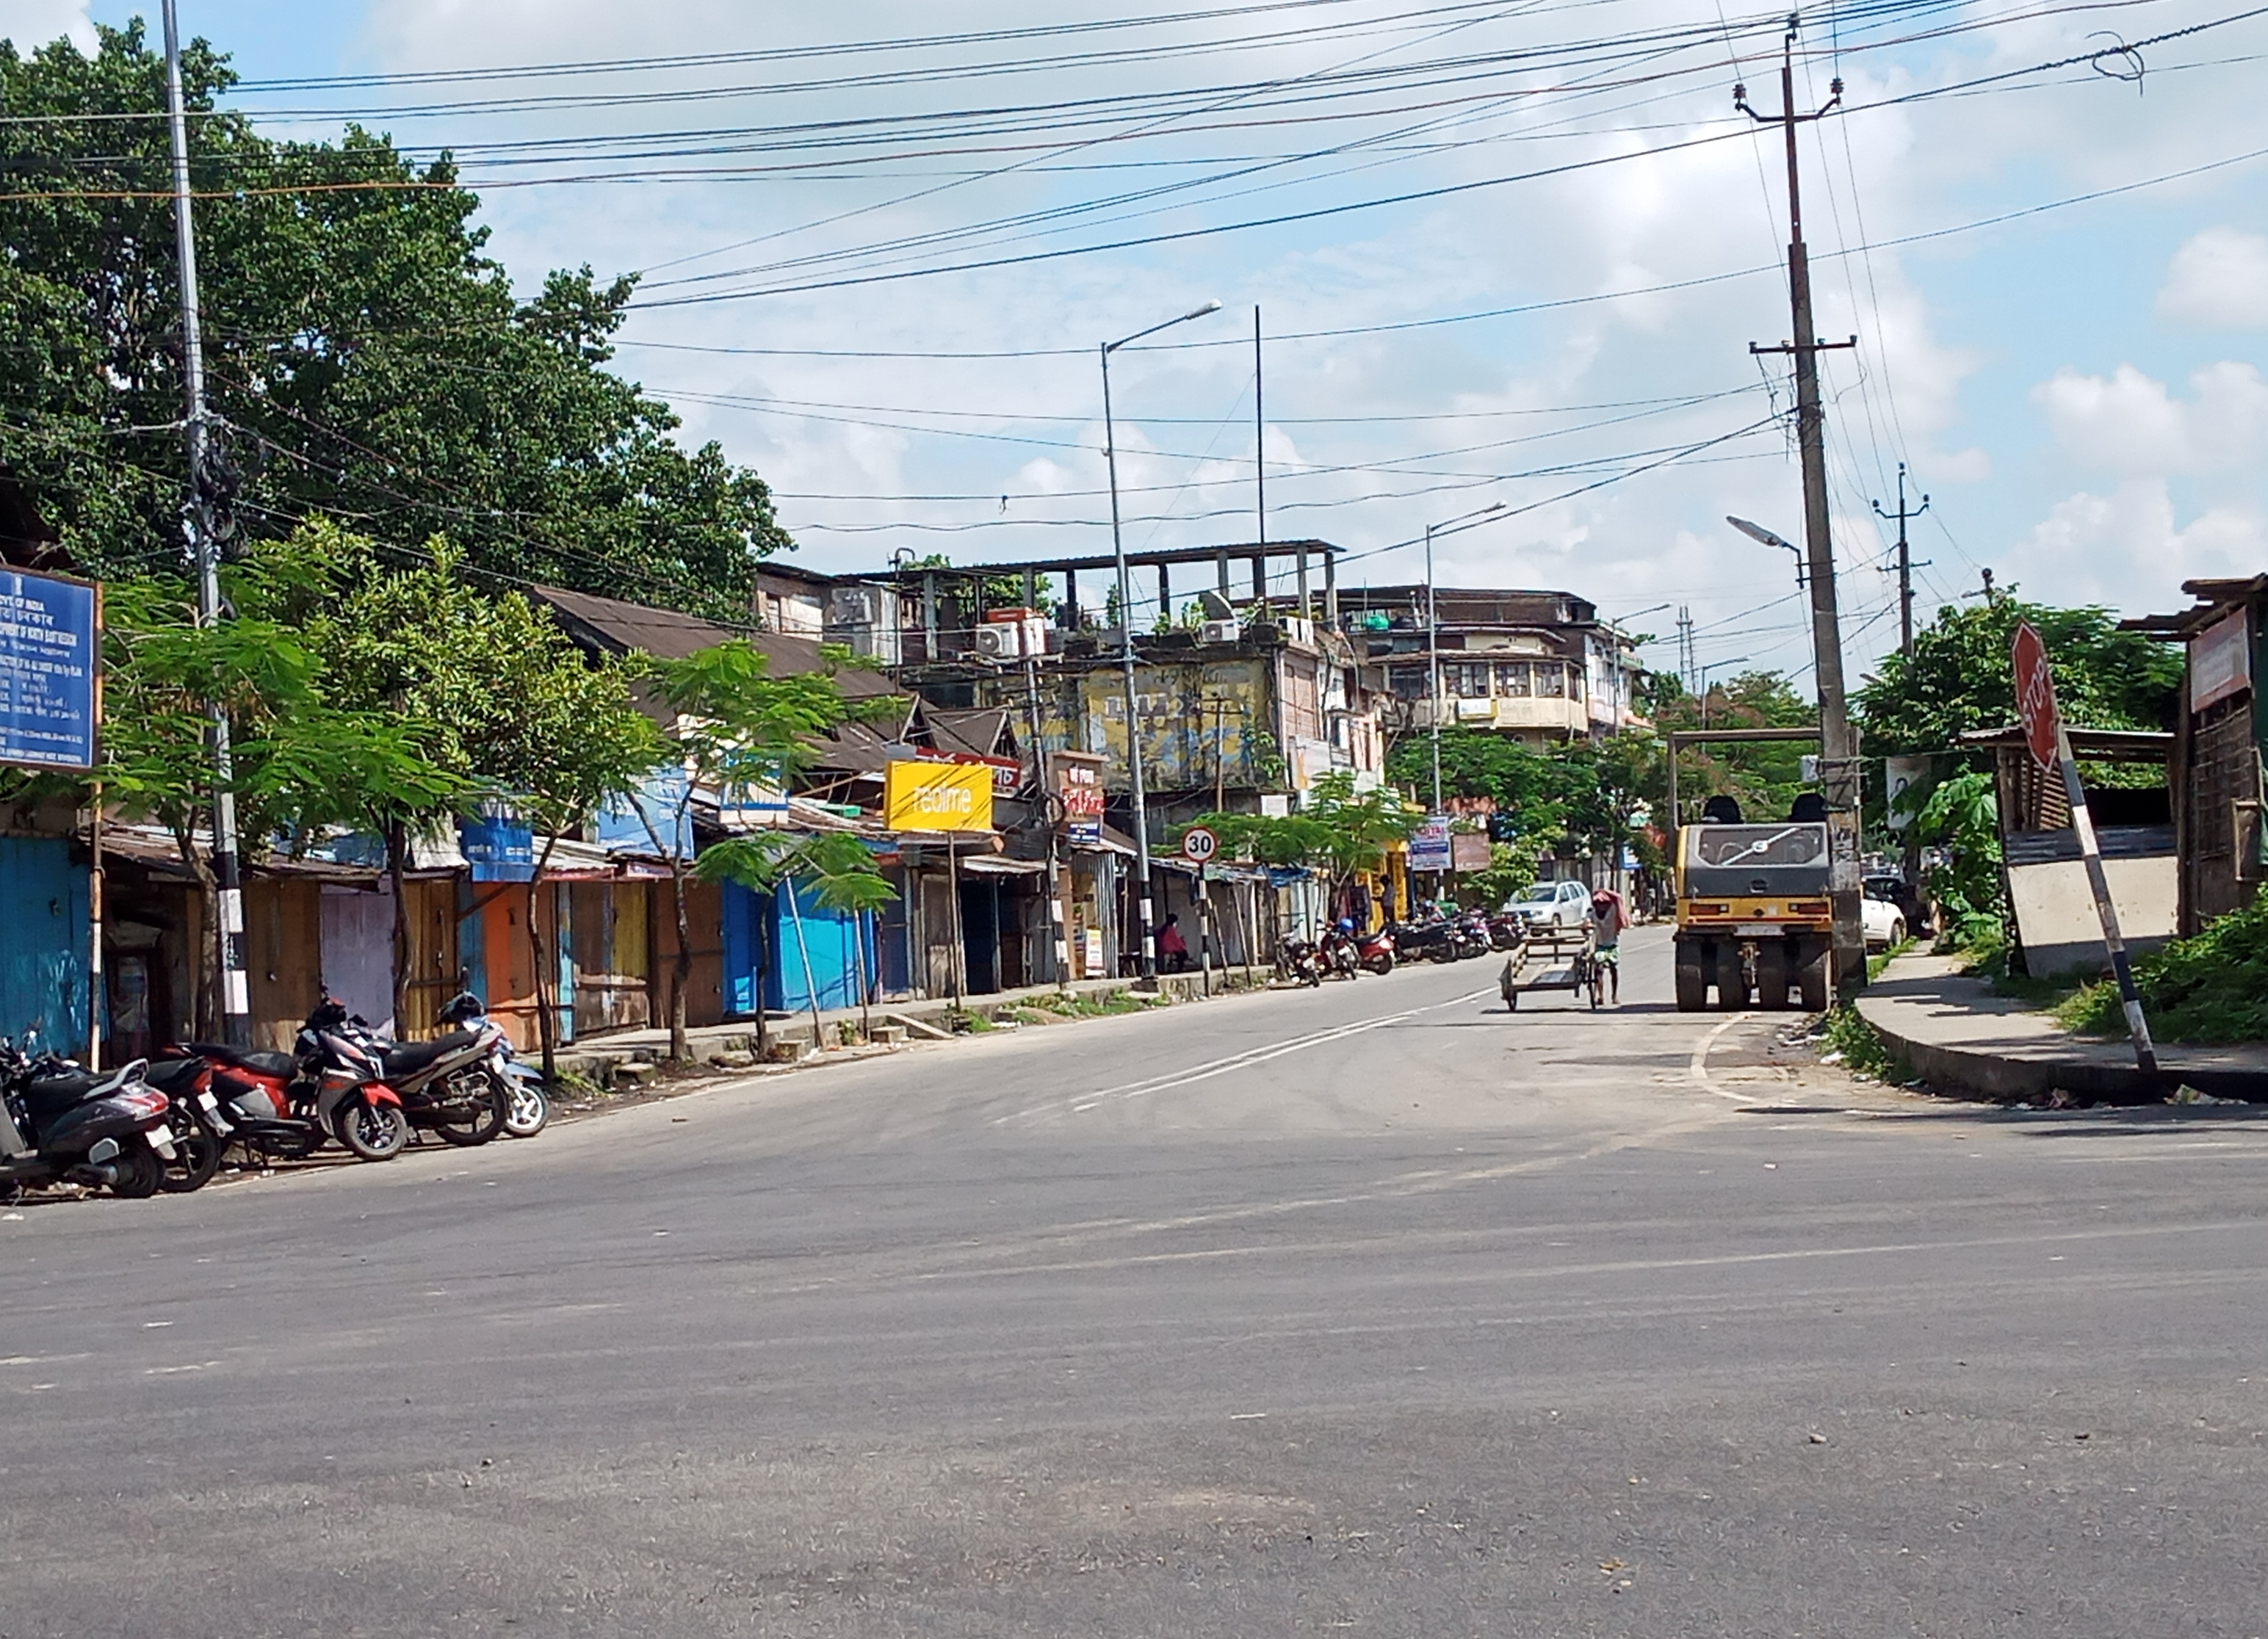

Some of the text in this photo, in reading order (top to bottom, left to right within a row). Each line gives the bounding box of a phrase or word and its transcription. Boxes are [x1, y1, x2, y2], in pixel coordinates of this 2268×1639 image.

[2023, 656, 2047, 737] STOP
[914, 781, 972, 813] realme
[1188, 836, 1211, 853] 30
